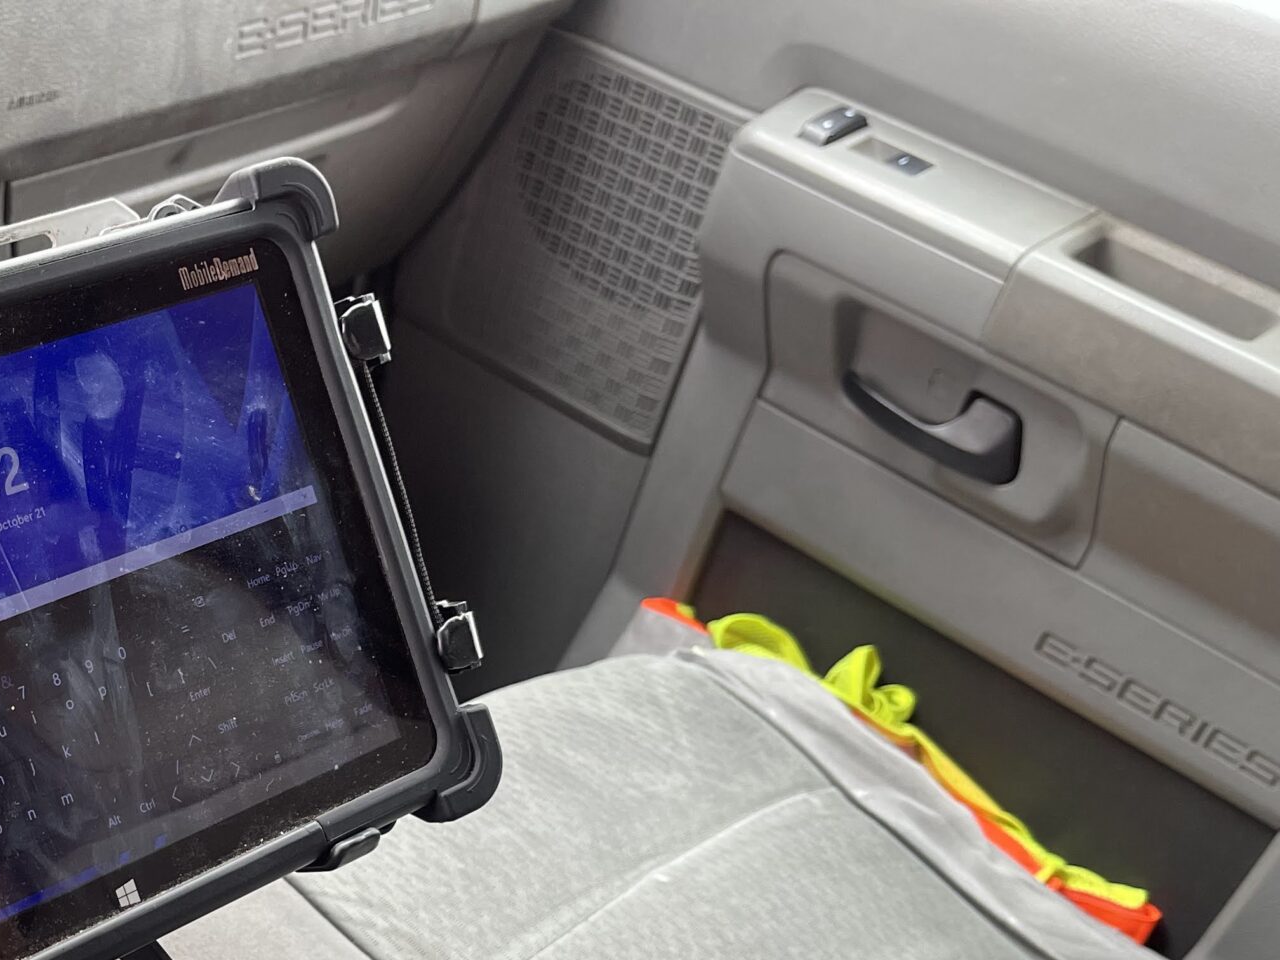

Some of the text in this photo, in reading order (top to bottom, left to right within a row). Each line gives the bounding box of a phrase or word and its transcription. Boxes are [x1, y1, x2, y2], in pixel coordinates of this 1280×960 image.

[178, 247, 259, 291] MobileDemand
[34, 506, 46, 520] 21
[246, 573, 271, 589] Home
[275, 560, 300, 577] PgUp
[259, 600, 311, 628] End PgDn
[17, 685, 26, 700] 7
[52, 672, 62, 687] 8
[84, 659, 94, 673] 9
[118, 646, 127, 660] 0
[30, 710, 37, 725] i
[65, 699, 74, 710] o
[98, 686, 107, 701] p
[222, 629, 237, 644] Del
[61, 745, 71, 759] k
[189, 687, 211, 702] Enter
[1034, 630, 1280, 788] E-SERIES
[28, 809, 37, 820] n
[61, 792, 75, 806] m
[218, 718, 238, 734] Shift
[108, 814, 123, 828] Alt
[139, 798, 157, 813] Ctrl
